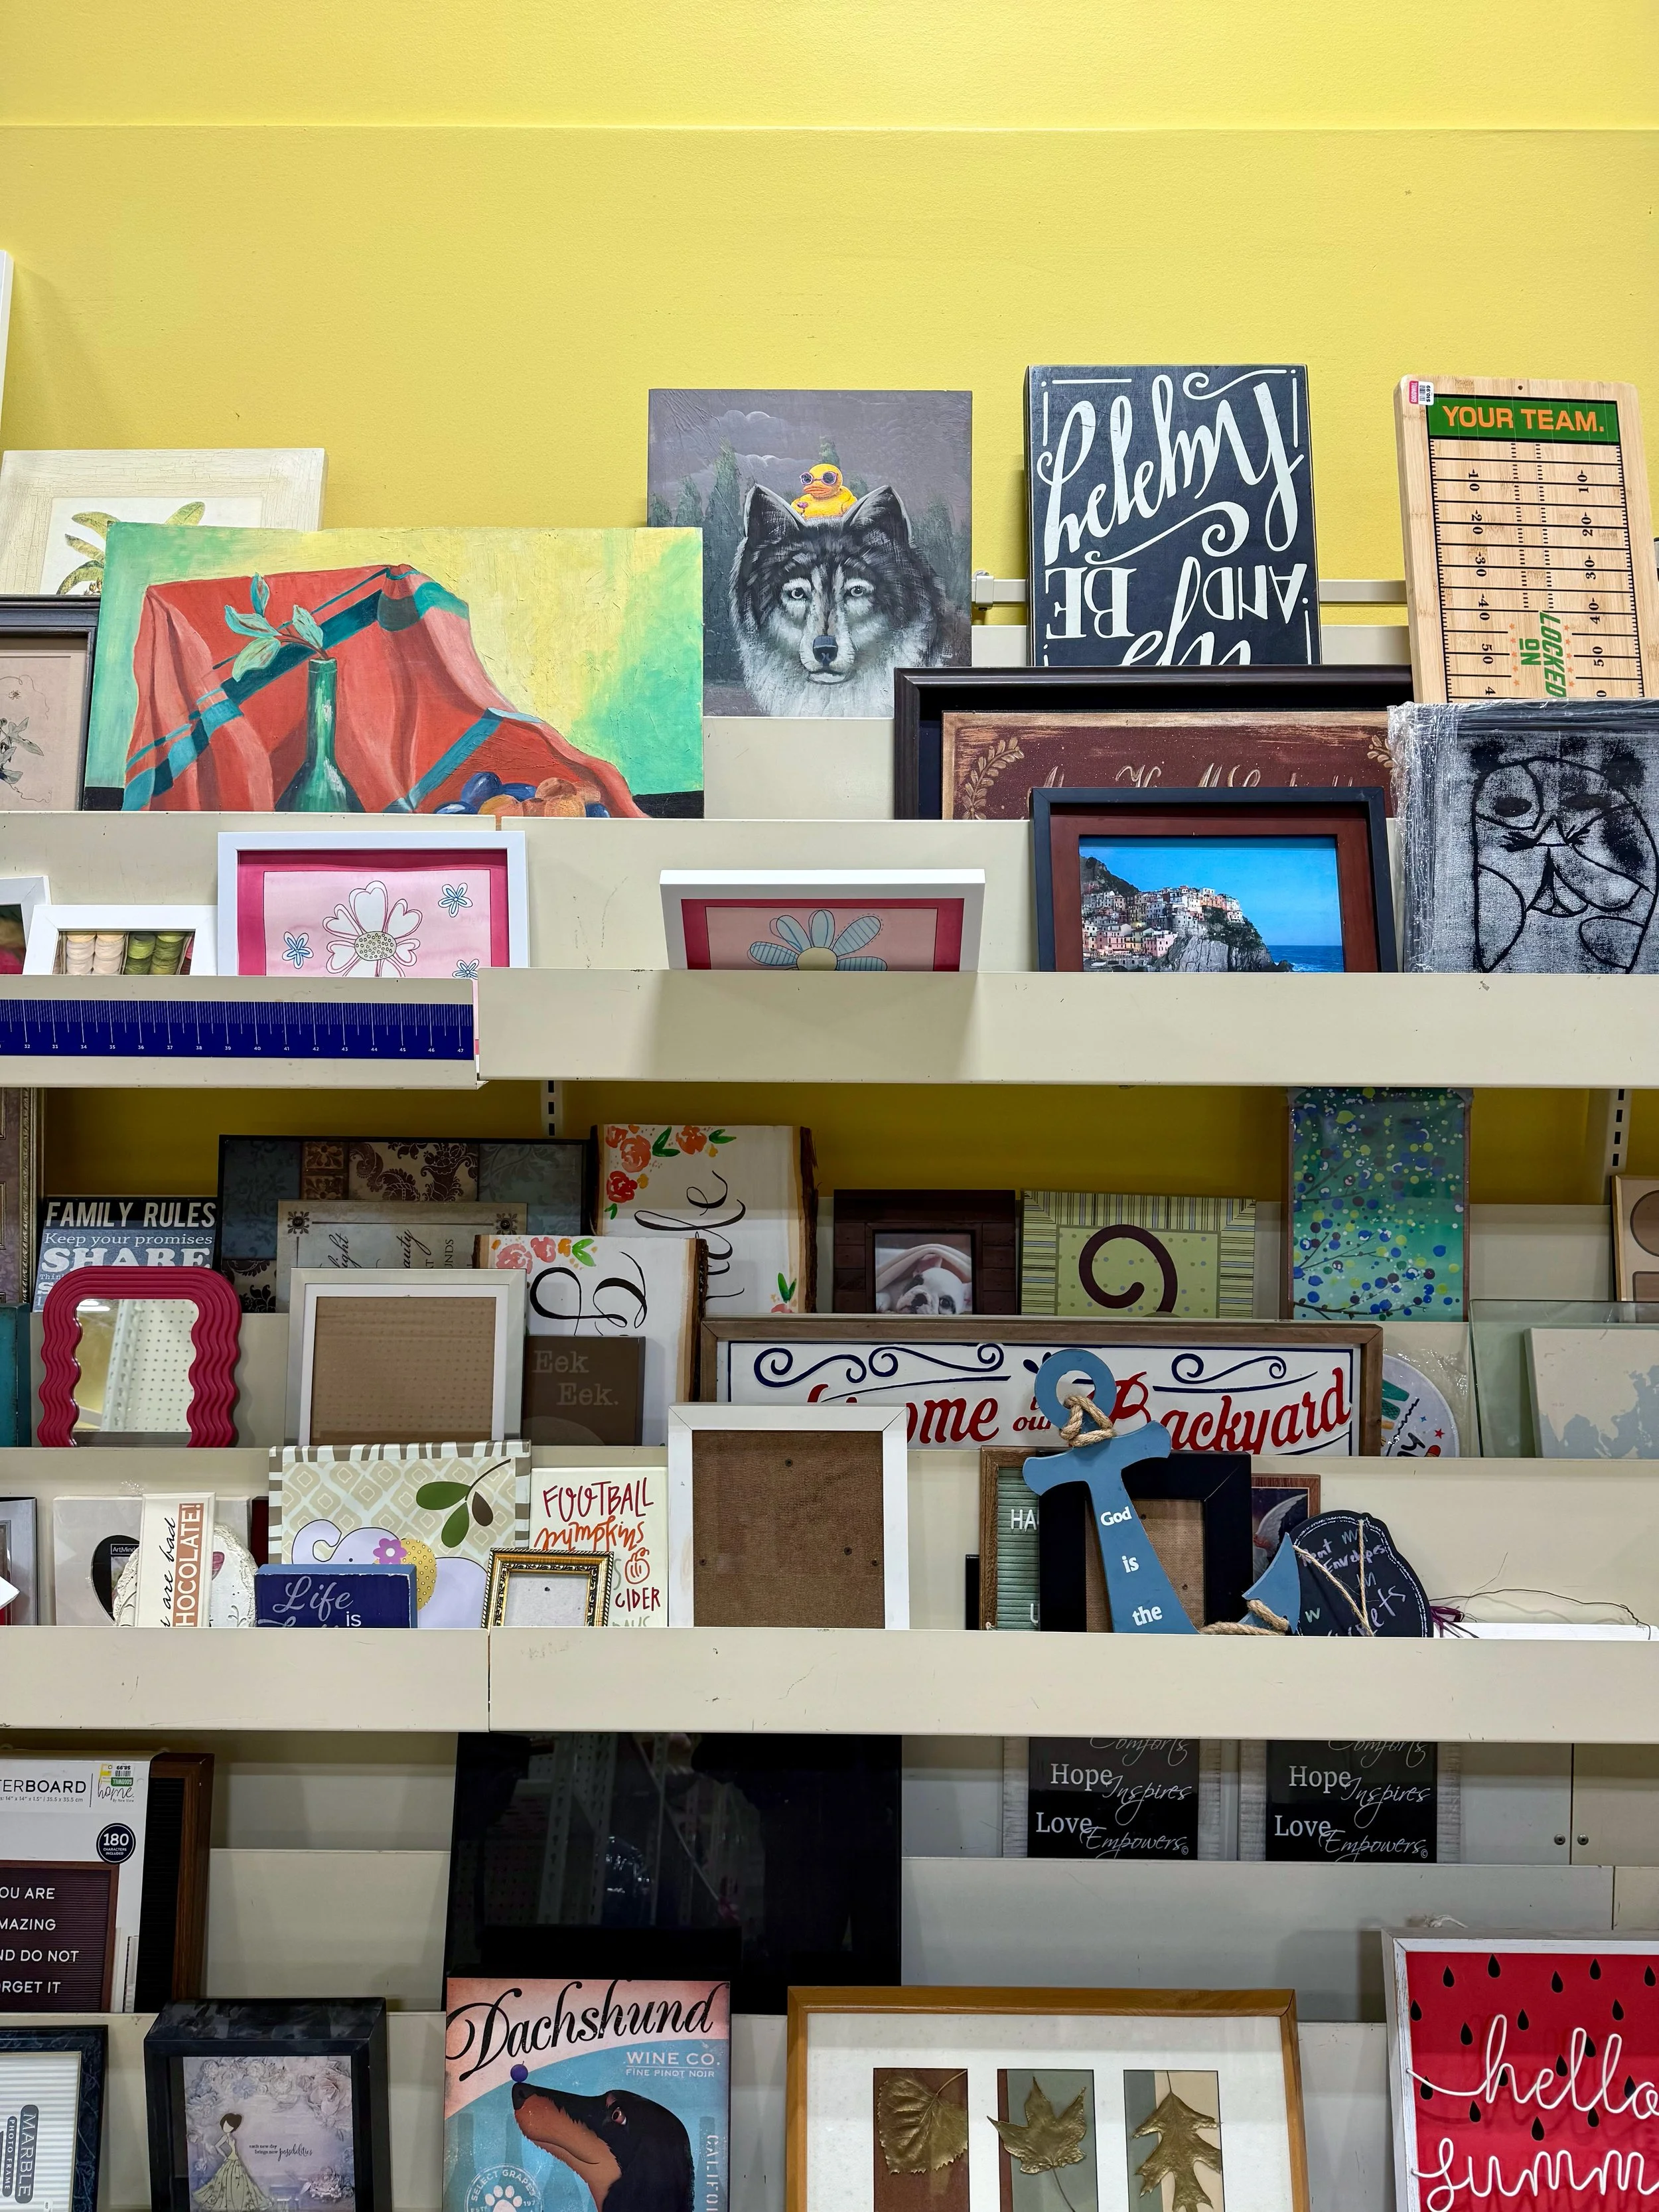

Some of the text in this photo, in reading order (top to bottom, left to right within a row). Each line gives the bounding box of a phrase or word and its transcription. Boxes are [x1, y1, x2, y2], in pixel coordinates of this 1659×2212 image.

[1442, 406, 1605, 432] YOUR TEAM.
[1037, 374, 1305, 566] happy
[1045, 567, 1137, 640] BE
[1202, 563, 1307, 625] AND
[1519, 638, 1542, 665] ON
[1540, 611, 1567, 698] LOCKED
[46, 1202, 216, 1228] FAMILY RULES
[44, 1233, 212, 1248] Keep your promises
[41, 1247, 210, 1273] SHARE
[532, 1351, 589, 1373] Eek
[556, 1383, 618, 1406] Eek.
[1086, 1367, 1352, 1454] Backyard
[543, 1477, 654, 1522] FOOTBALL
[1011, 1509, 1039, 1532] HA
[1100, 1505, 1132, 1527] God
[159, 1517, 176, 1562] bad
[176, 1505, 201, 1627] HOCOLATE!
[1121, 1555, 1140, 1574] is
[163, 1570, 173, 1610] are
[272, 1576, 354, 1621] Life
[615, 1587, 661, 1611] CIDER
[346, 1611, 361, 1627] is
[1132, 1603, 1163, 1627] the
[1050, 1763, 1192, 1826] Hope Inspires
[1289, 1765, 1431, 1828] Hope Inspires
[104, 1833, 129, 1846] 180
[1036, 1812, 1187, 1858] Love Empowers
[1275, 1815, 1426, 1862] Love Empowers
[0, 1887, 55, 1899] OU ARE
[0, 1918, 56, 1931] MAZING
[21, 1950, 42, 1962] DO
[48, 1951, 80, 1962] NOT
[1, 1980, 61, 1994] RGET IT
[445, 1980, 730, 2081] Dachshund
[626, 2051, 721, 2065] WINE CO.
[1407, 2014, 1659, 2119] hello
[626, 2068, 650, 2077] FINE
[654, 2069, 684, 2078] PINOT
[17, 2112, 36, 2196] MARBLE
[471, 2171, 498, 2201] SELECT
